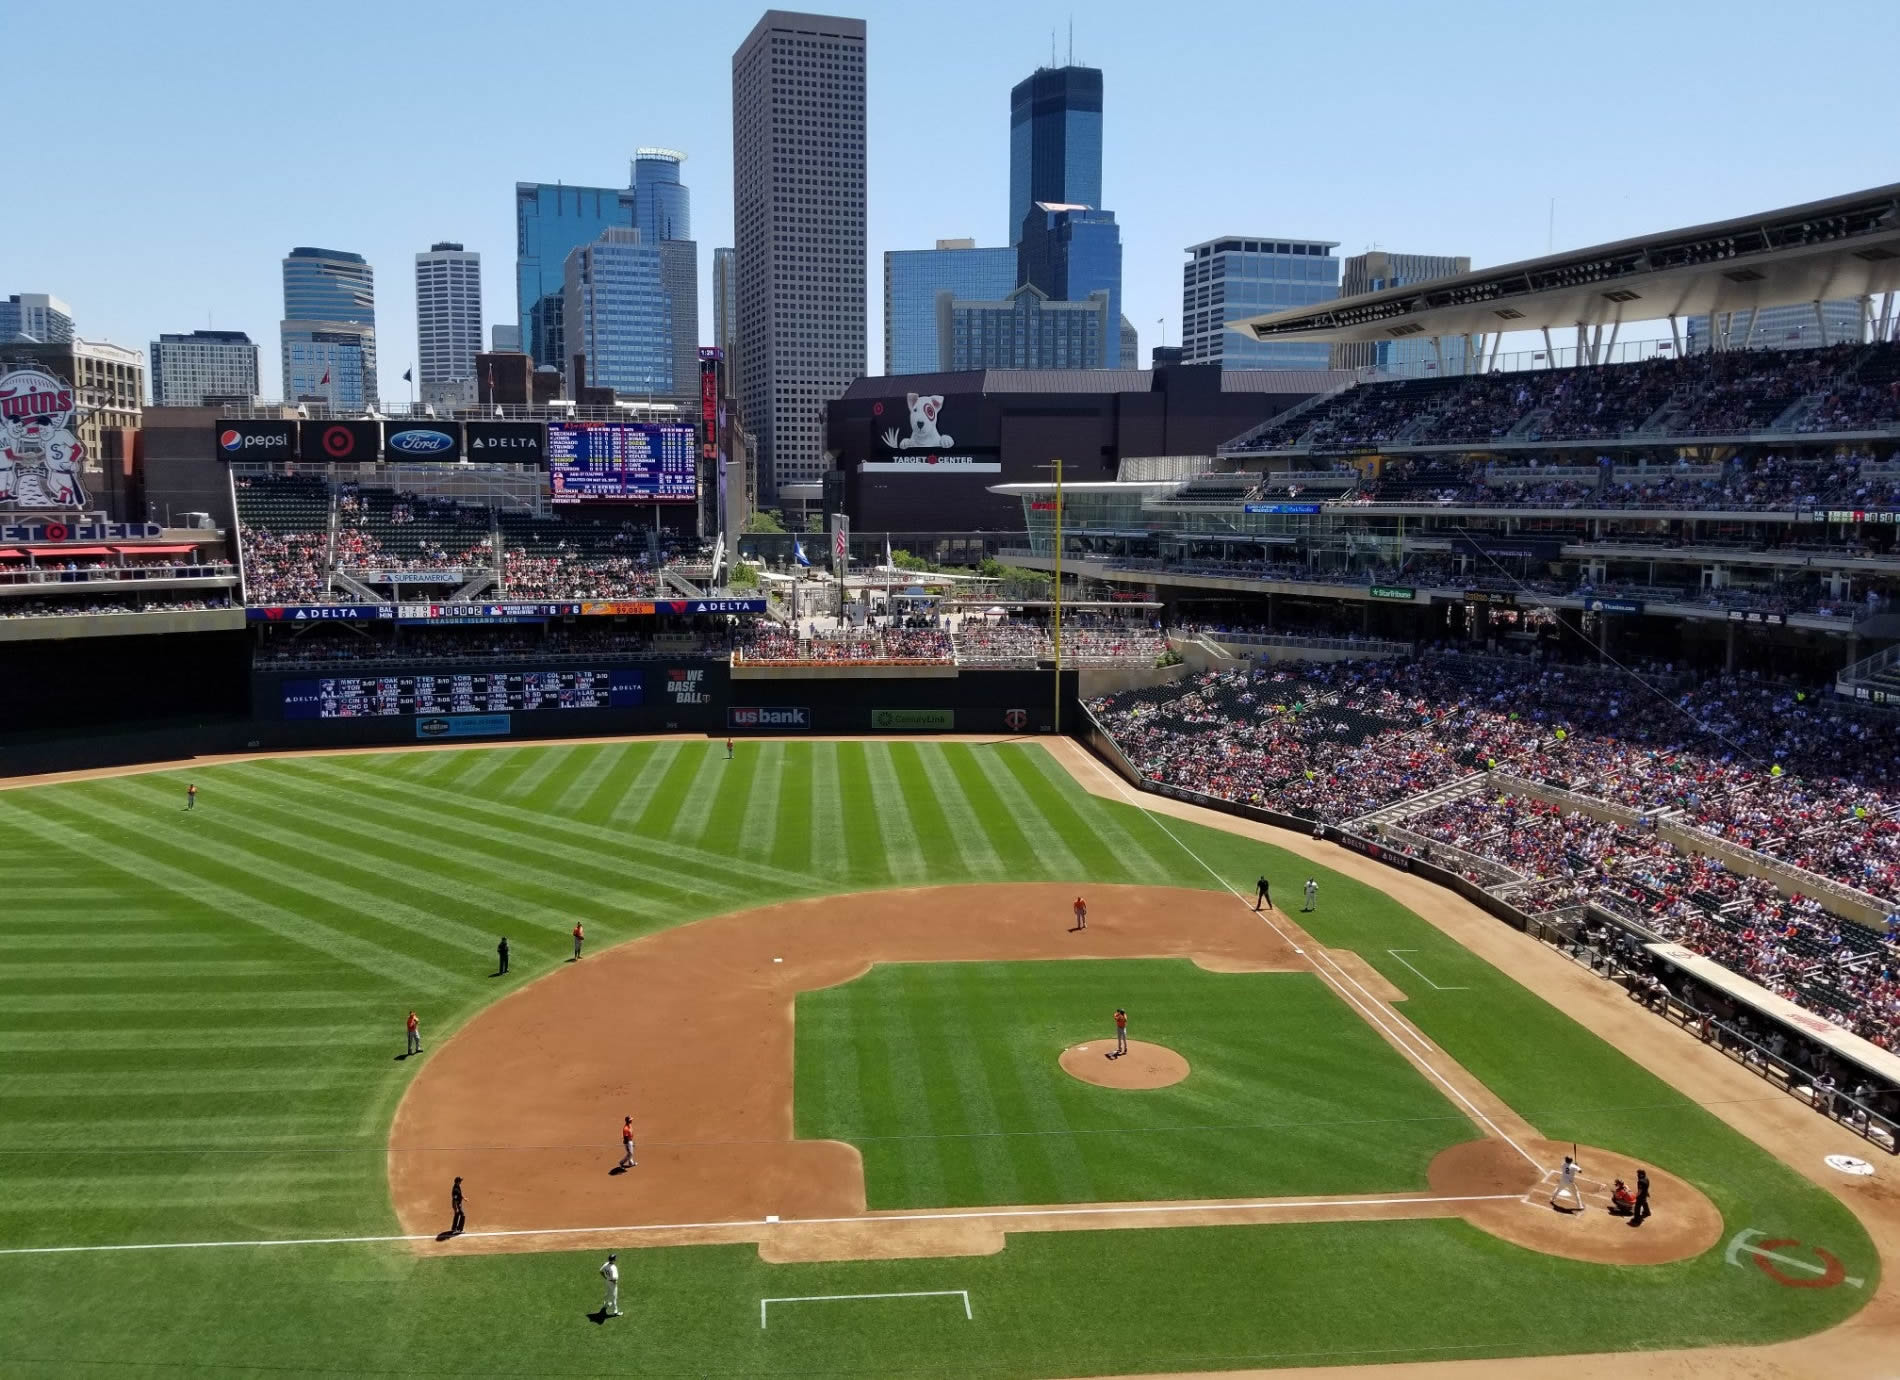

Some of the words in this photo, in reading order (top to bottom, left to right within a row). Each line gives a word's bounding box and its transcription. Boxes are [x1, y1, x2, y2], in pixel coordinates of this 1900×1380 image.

[0, 387, 73, 419] Twins
[245, 434, 287, 448] pepsi
[402, 430, 441, 449] Ford
[489, 438, 537, 448] DELTA
[75, 523, 163, 540] FIELD
[550, 604, 556, 614] 6
[573, 604, 579, 613] 6
[710, 602, 750, 610] DELTA
[311, 608, 358, 618] DELTA
[687, 670, 704, 681] WE
[667, 681, 696, 692] BASE
[321, 690, 340, 699] A.L.
[676, 692, 702, 703] BALL
[1347, 838, 1366, 850] DELTA
[1388, 854, 1408, 866] DELTA
